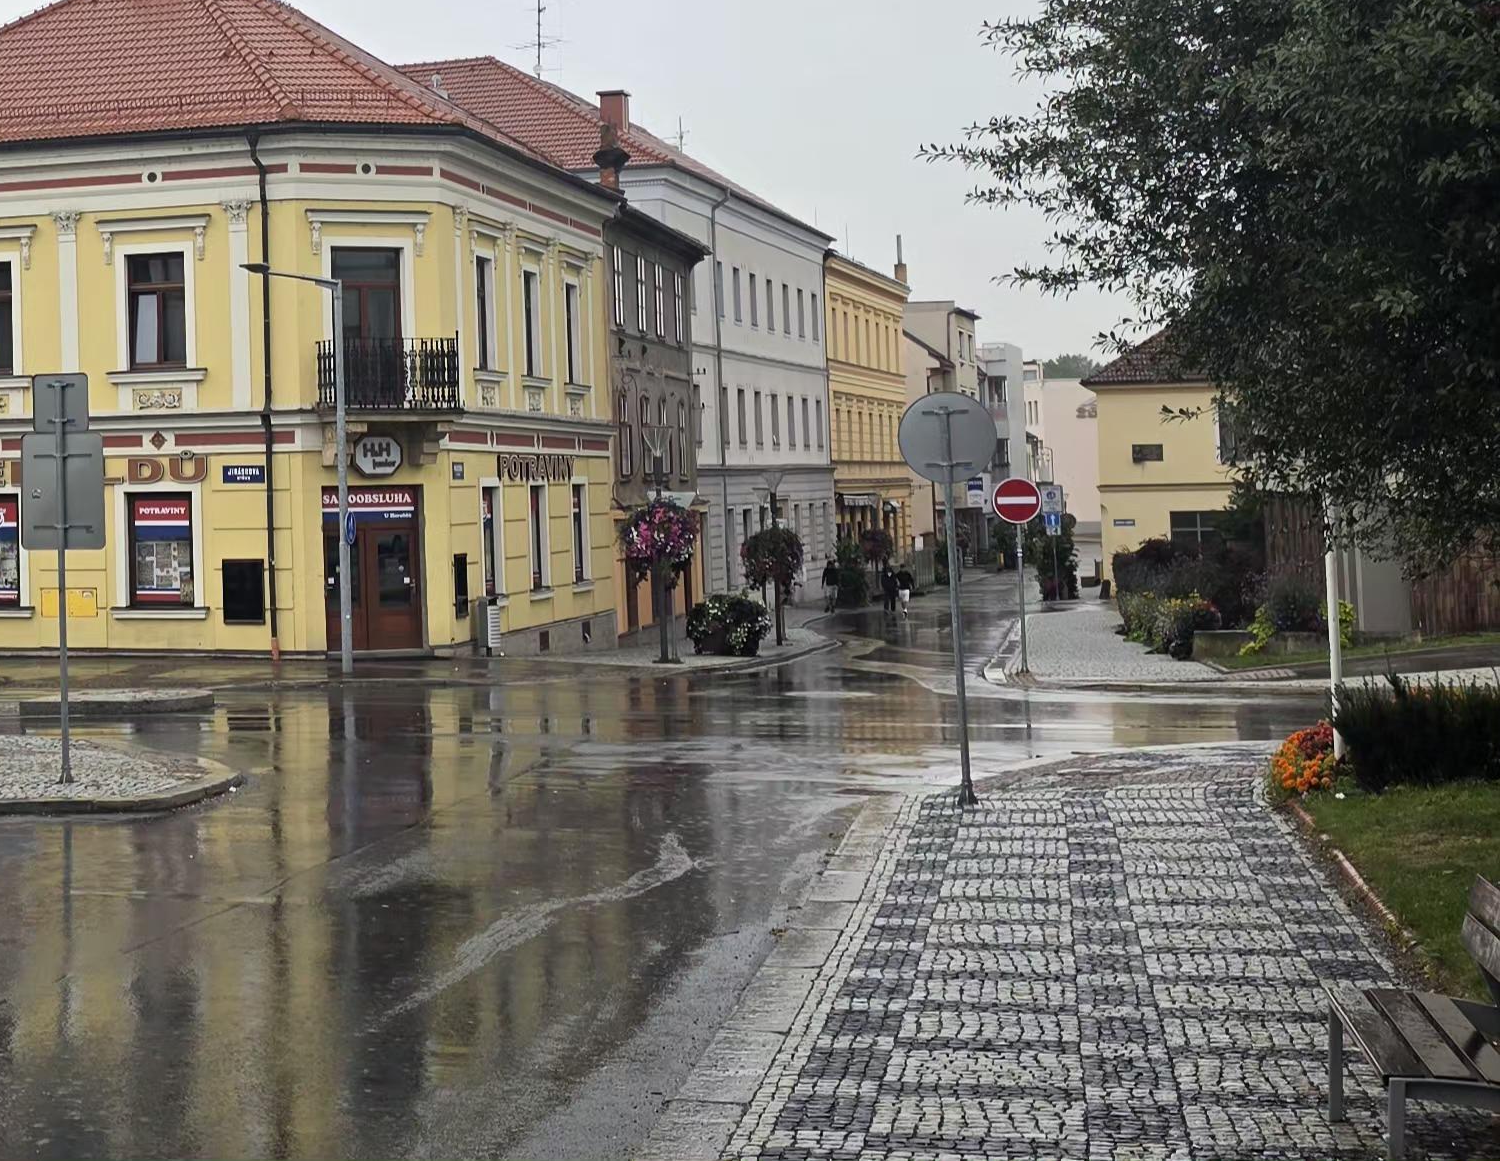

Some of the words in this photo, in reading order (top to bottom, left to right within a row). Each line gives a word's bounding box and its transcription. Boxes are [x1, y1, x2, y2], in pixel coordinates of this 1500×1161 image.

[497, 454, 578, 482] POTRAVINY
[322, 493, 411, 504] SAOOBSLUHA
[139, 506, 186, 515] POTRAVINY
